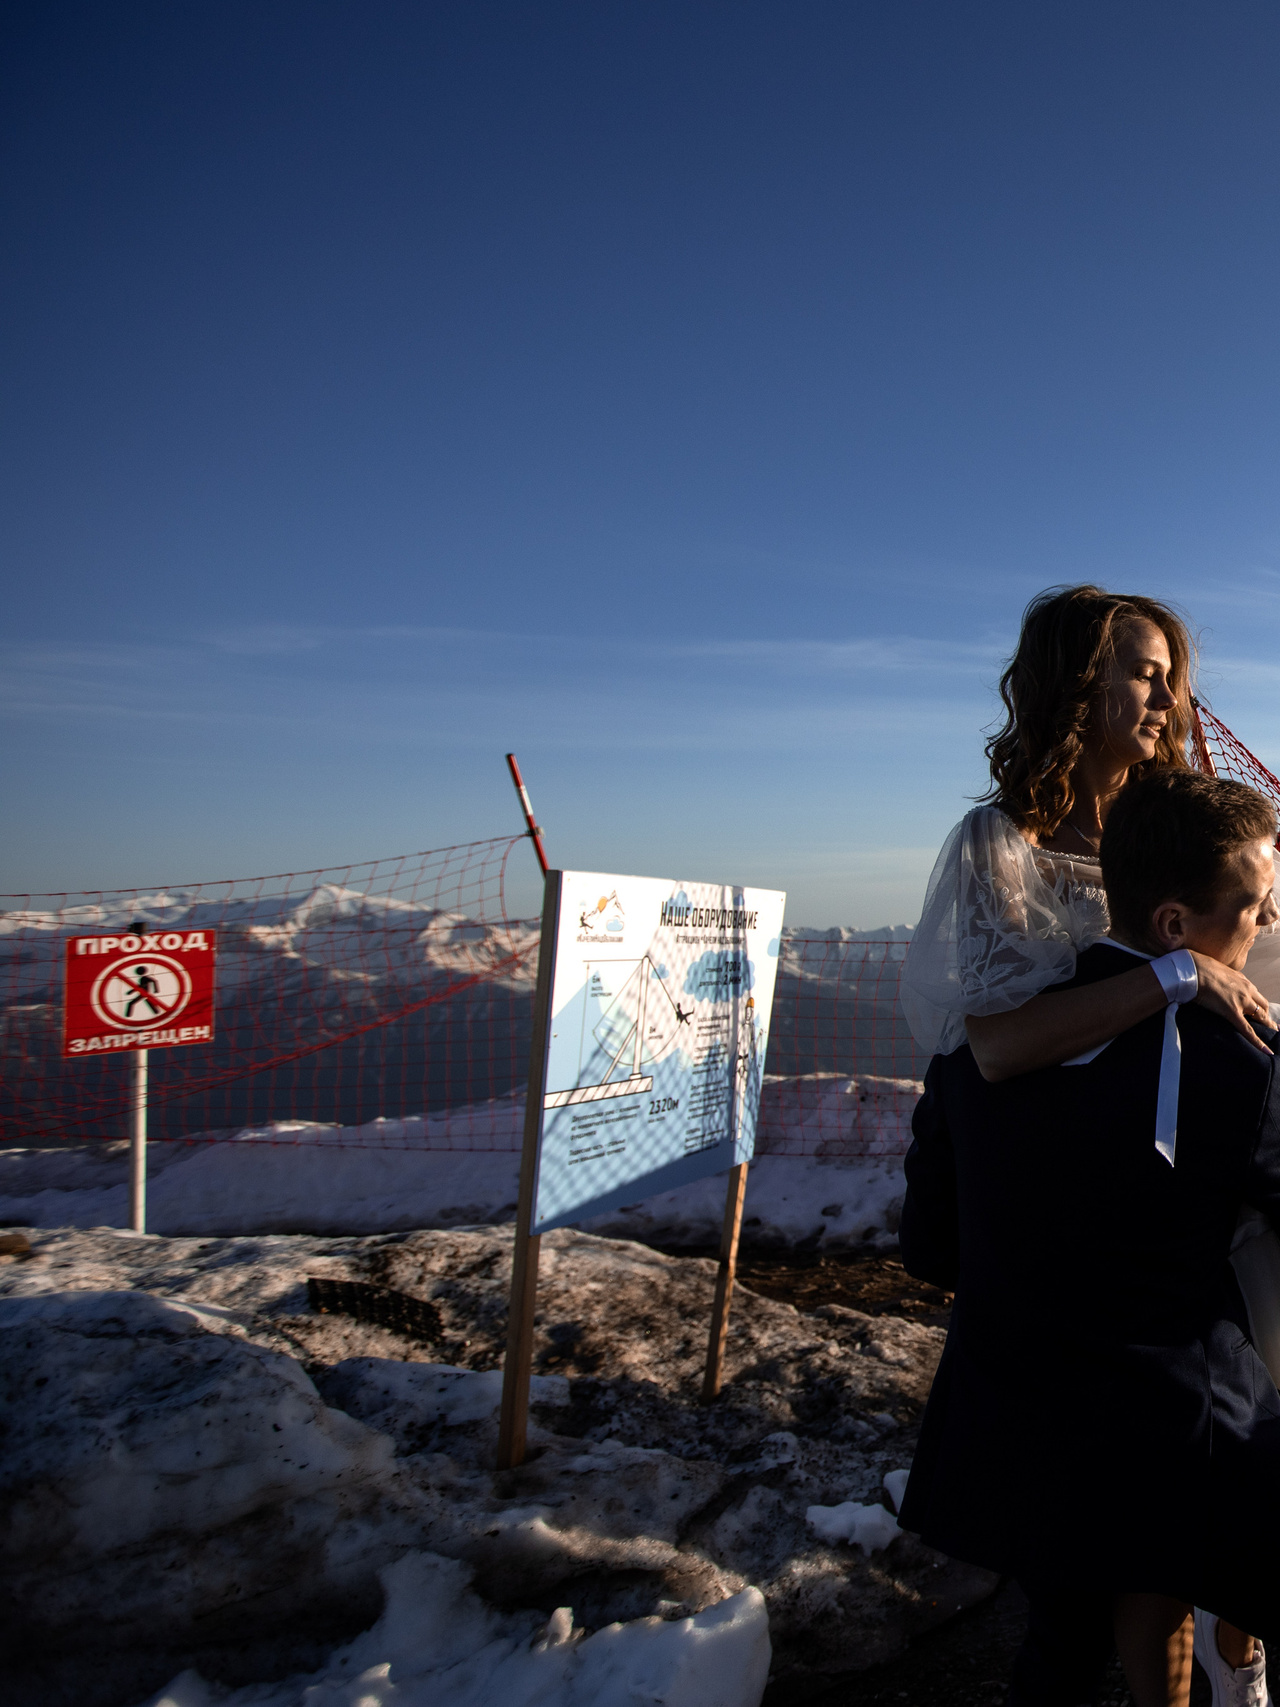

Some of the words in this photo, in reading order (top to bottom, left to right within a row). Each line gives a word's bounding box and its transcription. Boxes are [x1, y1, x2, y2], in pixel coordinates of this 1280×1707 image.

[660, 901, 690, 927] НАШЕ
[692, 907, 758, 931] ОБОРУДОВАНИЕ
[76, 933, 209, 955] ПРОХОД
[68, 1025, 211, 1053] ЗАПРЕЩЕН
